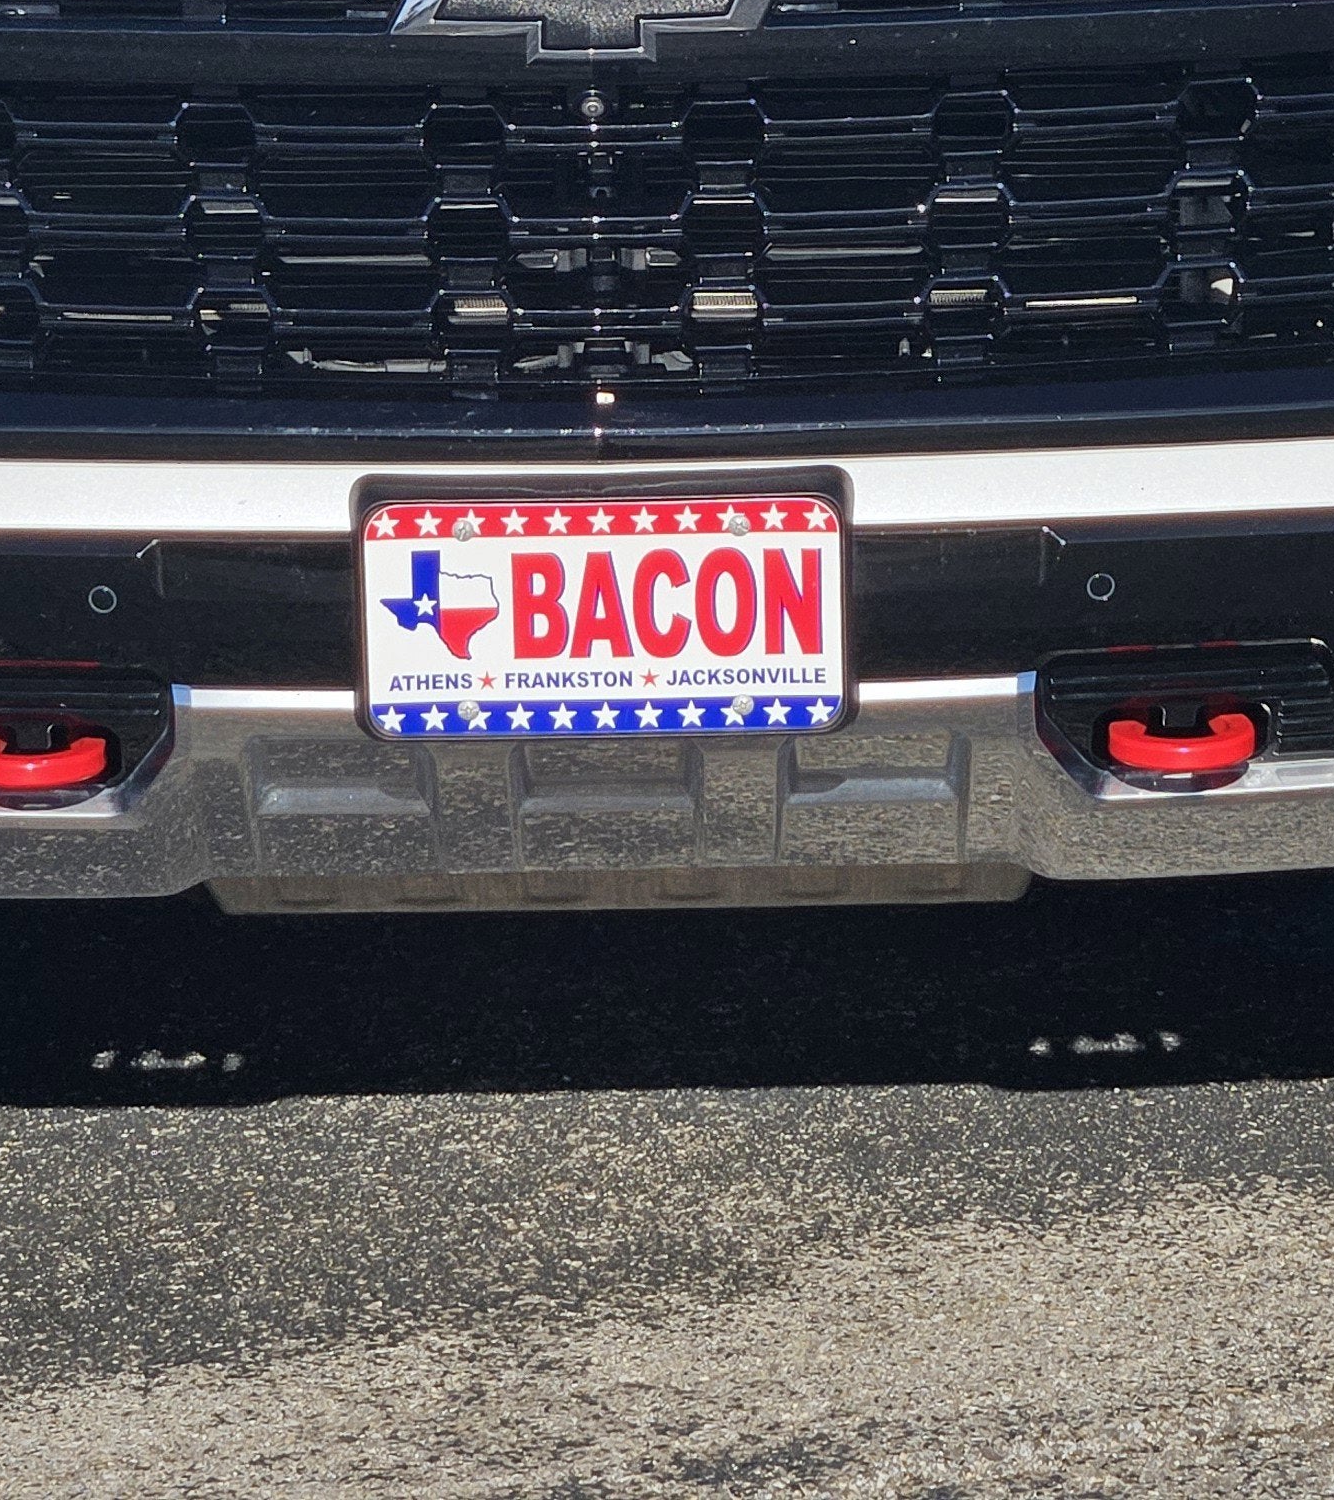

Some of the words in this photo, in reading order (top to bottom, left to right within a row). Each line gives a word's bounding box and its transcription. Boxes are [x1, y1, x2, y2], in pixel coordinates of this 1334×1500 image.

[510, 546, 824, 660] BACON
[388, 672, 473, 693] ATHENS
[504, 669, 634, 690] FRANKSTON
[666, 666, 827, 688] JACKSONVILLE
